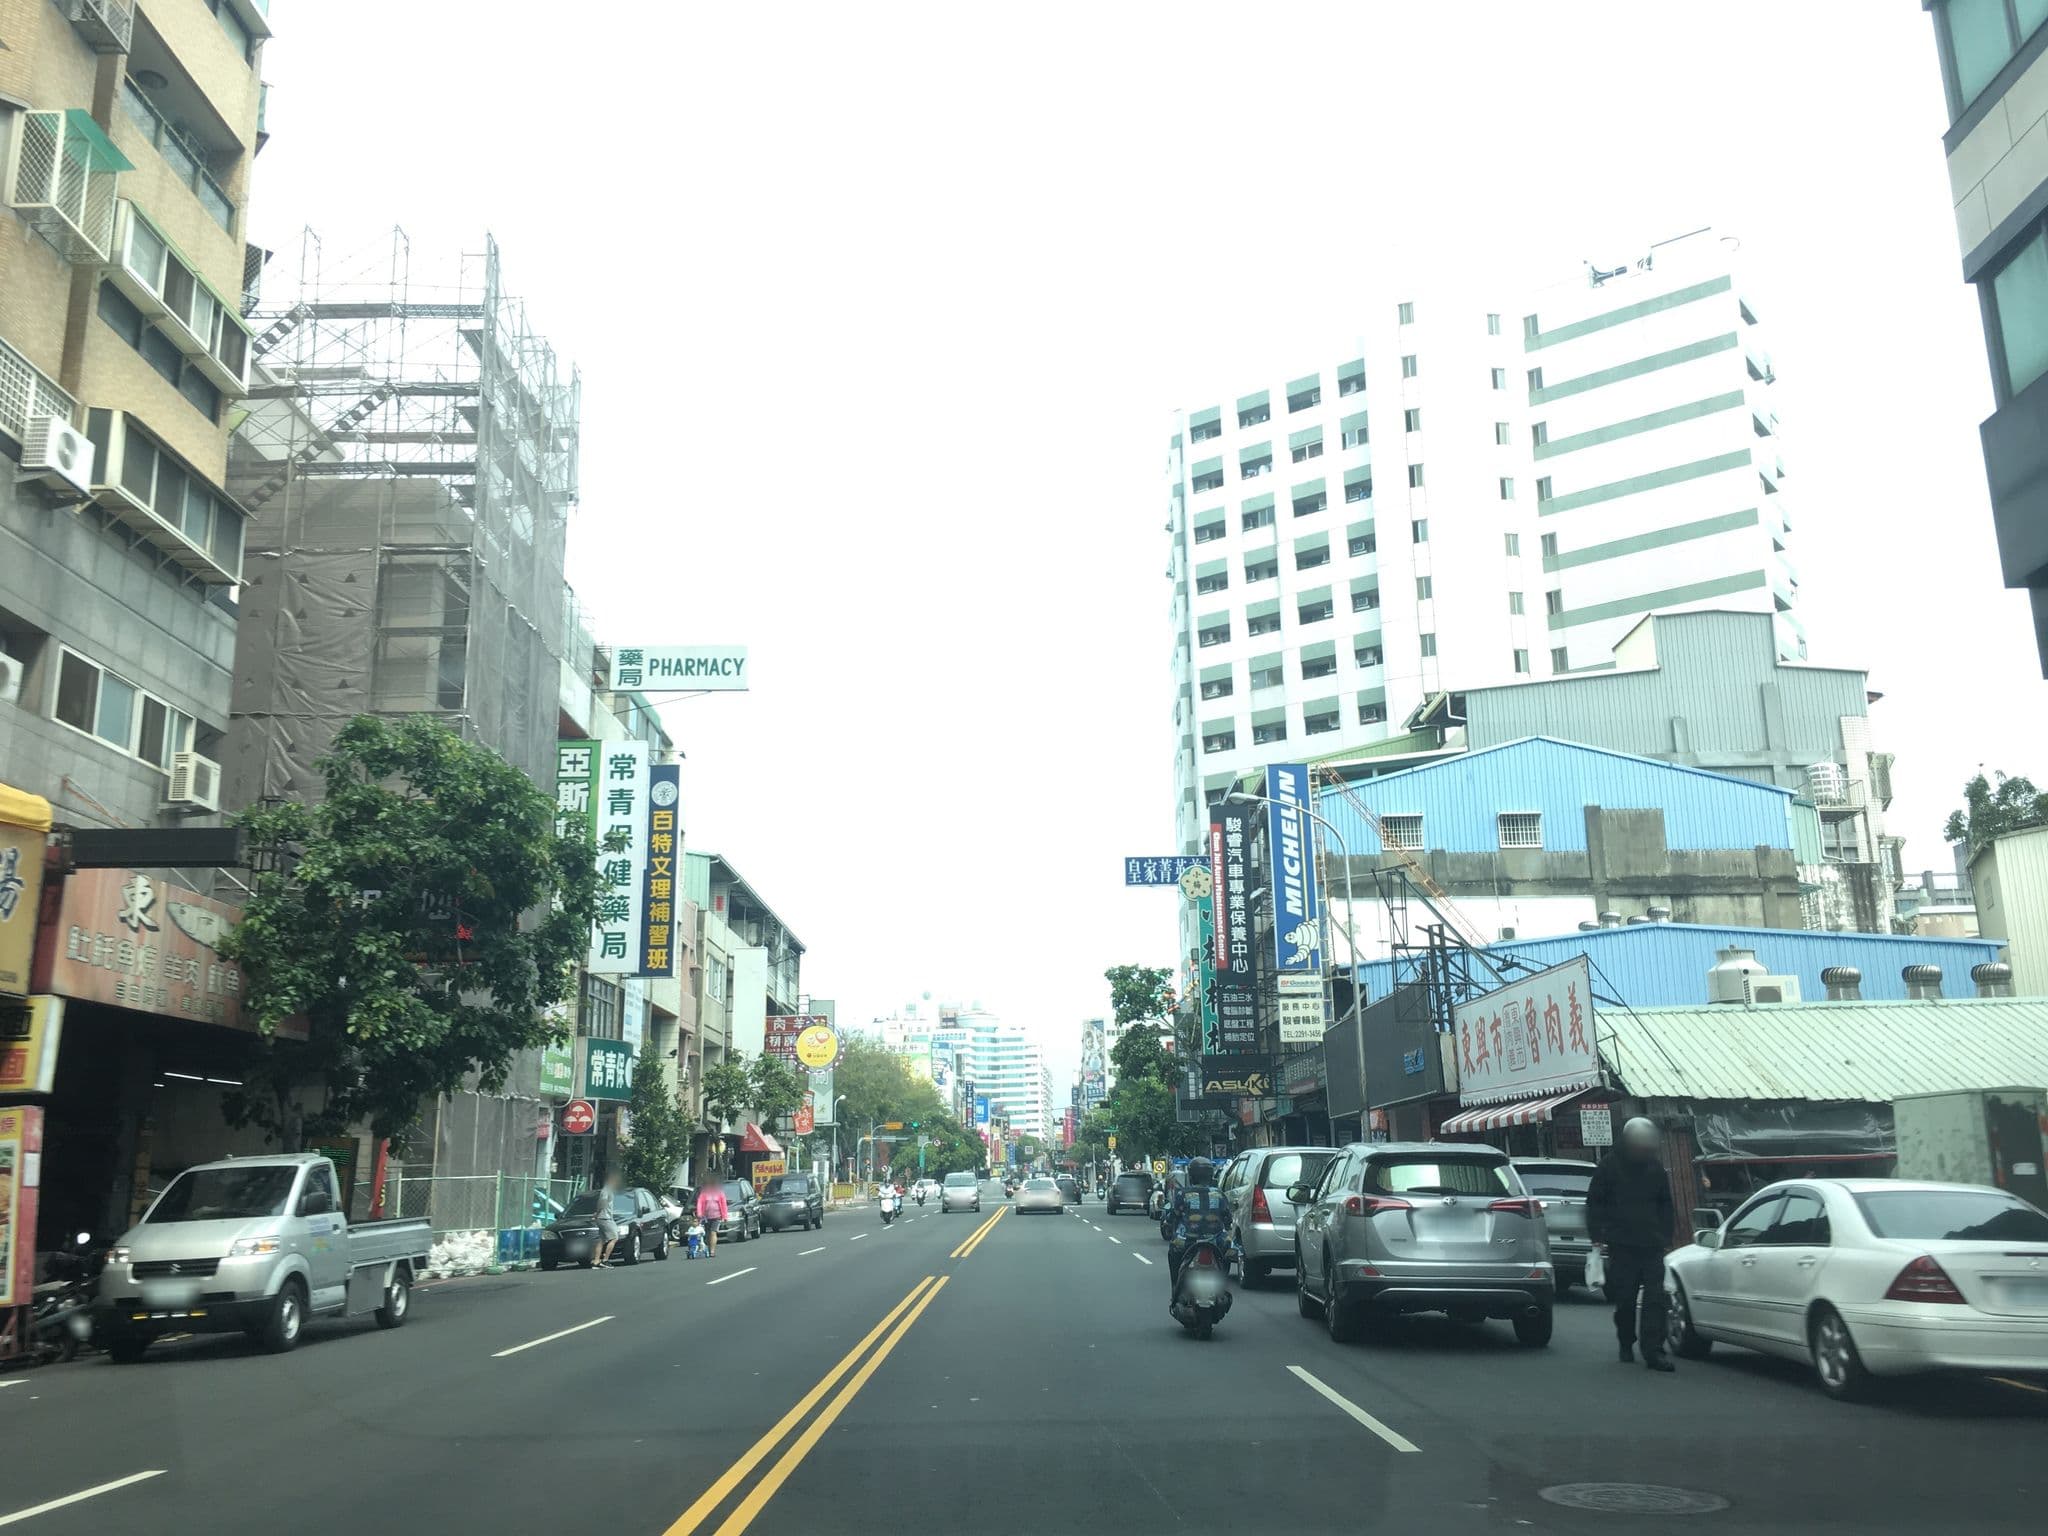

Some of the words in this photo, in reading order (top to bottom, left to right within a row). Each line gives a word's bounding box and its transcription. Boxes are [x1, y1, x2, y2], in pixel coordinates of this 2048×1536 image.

[617, 648, 645, 687] 藥局
[649, 657, 745, 677] PHARMACY
[600, 752, 637, 960] 常青保健藥局
[1278, 769, 1303, 917] MICHELIN
[118, 874, 160, 933] 東
[646, 809, 674, 970] 百特文理補習班
[1215, 885, 1224, 933] Maintenance
[1225, 817, 1249, 974] 駿睿汽車專業保養中心
[1217, 934, 1225, 960] Center
[1282, 1002, 1320, 1011] 服務中心
[1282, 1015, 1320, 1025] 駿睿輪胎
